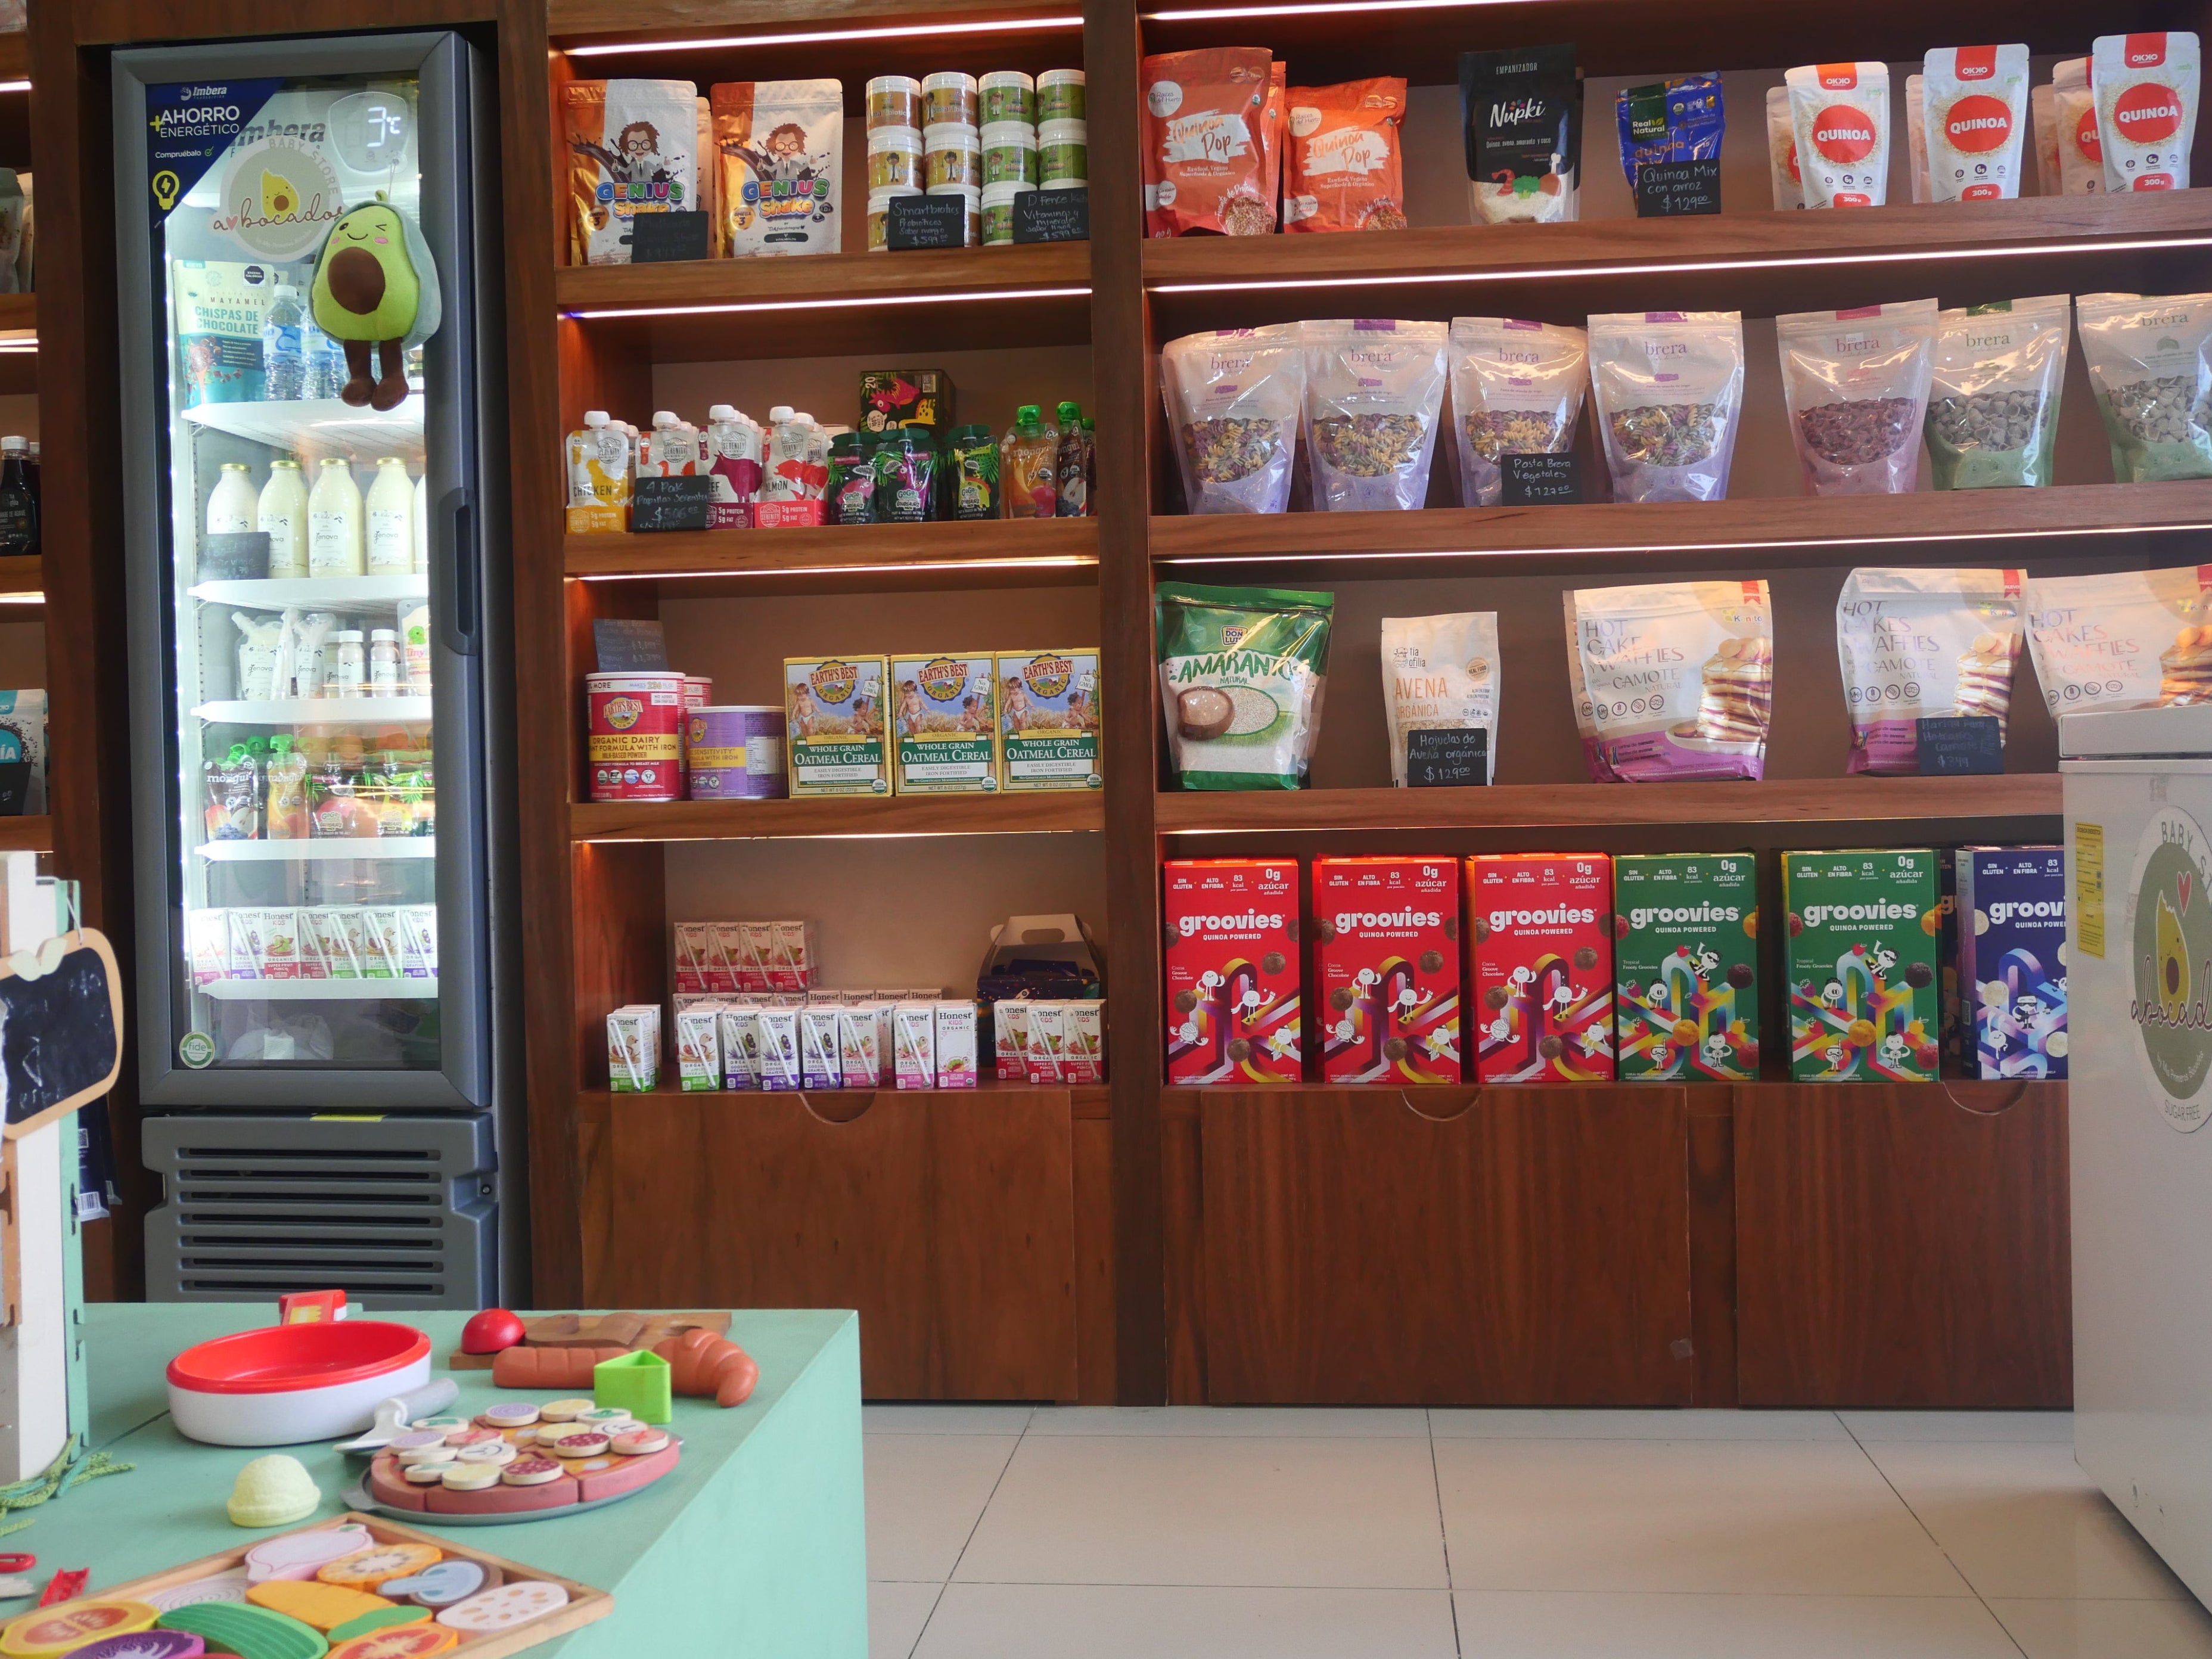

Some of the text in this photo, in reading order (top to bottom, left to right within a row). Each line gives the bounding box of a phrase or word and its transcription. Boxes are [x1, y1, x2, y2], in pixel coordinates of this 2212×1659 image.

[1496, 63, 1537, 75] EMPANIZADOR
[193, 86, 227, 96] Imbera
[160, 105, 240, 124] AHORRO
[1490, 98, 1545, 128] Nupki
[2119, 105, 2178, 123] QUINOA
[160, 123, 240, 138] ENERGÉTICO
[1173, 115, 1225, 144] Quinoa
[1633, 125, 1665, 134] Natural
[1950, 117, 2008, 135] QUINOA
[1817, 129, 1871, 142] QUINOA
[1201, 132, 1231, 159] Pop
[1312, 132, 1363, 159] Quinoa
[155, 150, 201, 159] Compruébalo
[1341, 146, 1371, 172] Pop
[1644, 166, 1717, 183] Quinoa Mix
[596, 181, 684, 200] GENIUS
[741, 179, 830, 200] GENIUS
[1647, 185, 1667, 193] con
[893, 202, 959, 216] Smartbiotics
[210, 297, 265, 306] MAYAMEL
[195, 306, 259, 322] CHISPAS DE
[195, 318, 258, 334] CHOCOLATE
[1835, 337, 1880, 353] brera
[1966, 332, 2011, 349] brera
[1351, 349, 1393, 362] brera
[1499, 347, 1539, 364] brera
[1645, 341, 1687, 356] brera
[1210, 356, 1250, 370] brera
[1514, 459, 1543, 468] Pasta
[573, 484, 612, 498] CHICKEN
[1586, 620, 1628, 638] HOT
[840, 665, 858, 680] BEST
[950, 663, 968, 677] BEST
[1054, 660, 1073, 673] BEST
[1219, 676, 1250, 685] NATURAL
[1613, 668, 1680, 689] CAMOTE
[1395, 678, 1447, 700] AVENA
[628, 699, 644, 713] BEST
[631, 736, 660, 744] DAIRY
[1419, 733, 1476, 748] Hojuelas de
[794, 751, 881, 765] OATMEAL CEREAL
[902, 750, 992, 763] OATMEAL CEREAL
[1006, 747, 1096, 760] OATMEAL CEREAL
[1890, 869, 1923, 878] azúcar
[1258, 881, 1288, 890] azúcar
[264, 912, 294, 921] Honest
[1490, 903, 1595, 932] groovies
[1630, 900, 1739, 930] groovies
[1804, 897, 1917, 927] groovies
[1179, 908, 1283, 937] groovies
[1335, 906, 1440, 934] groovies
[939, 1012, 973, 1021] Honest
